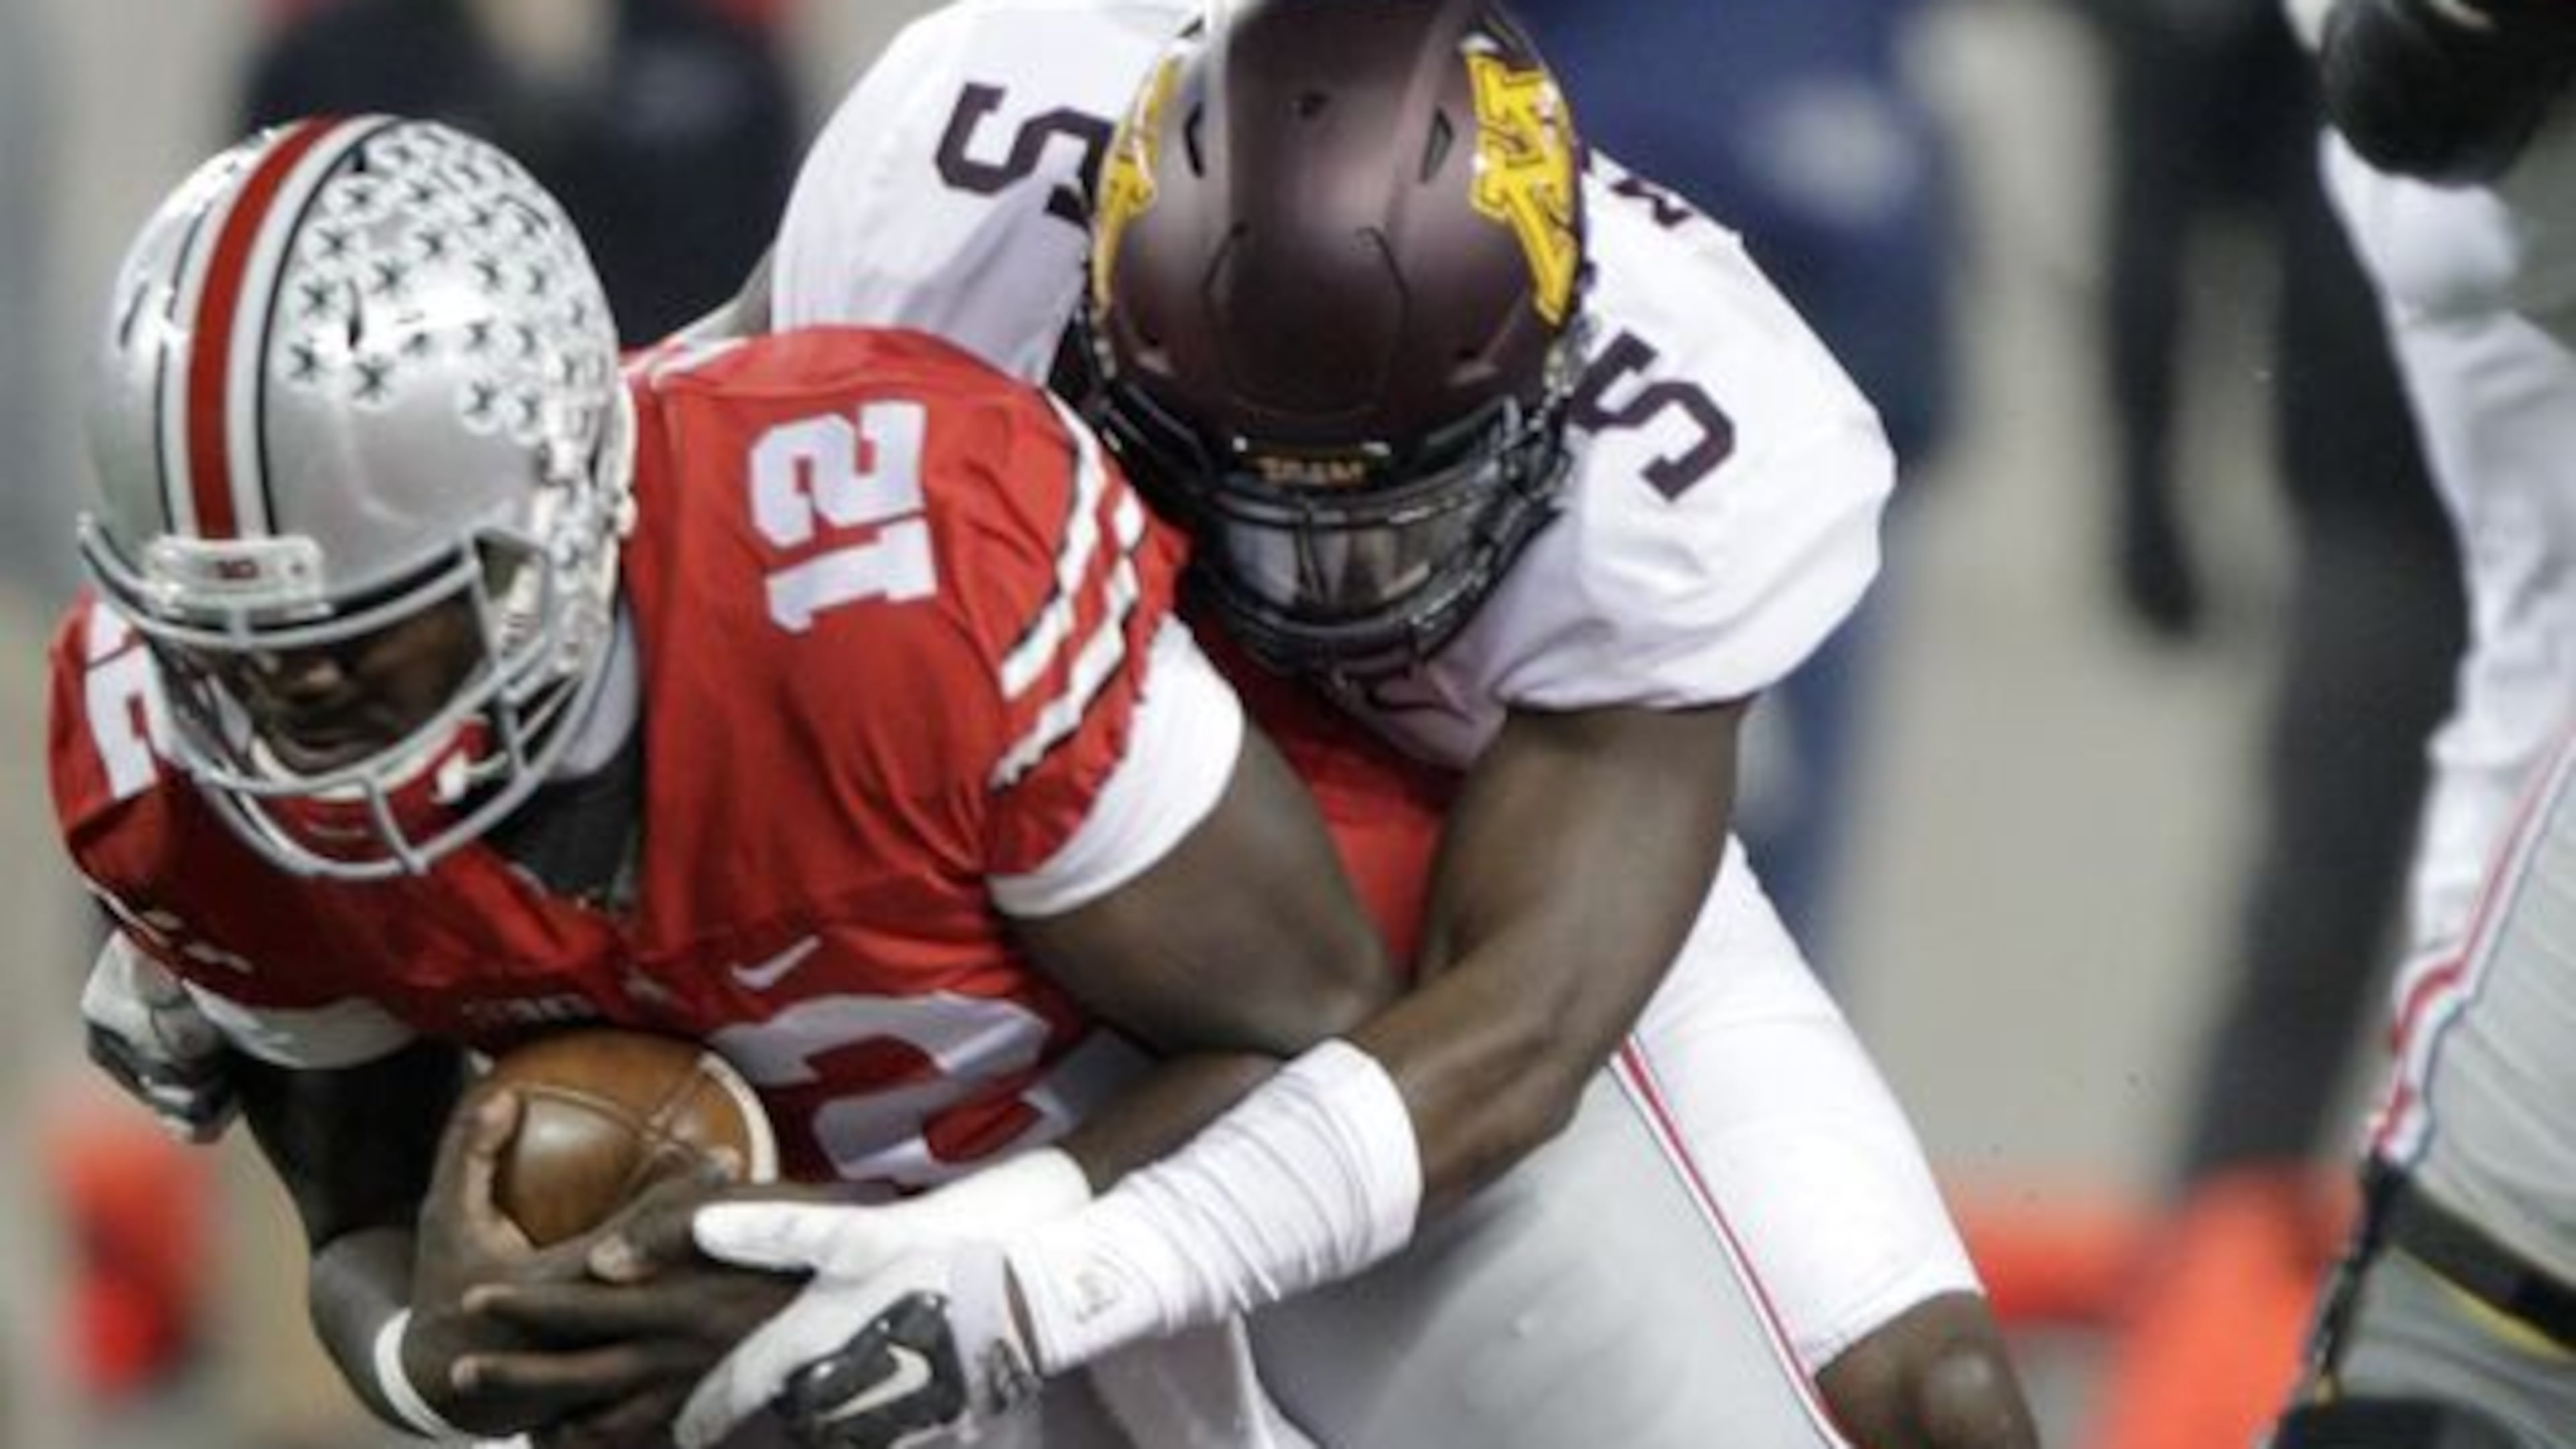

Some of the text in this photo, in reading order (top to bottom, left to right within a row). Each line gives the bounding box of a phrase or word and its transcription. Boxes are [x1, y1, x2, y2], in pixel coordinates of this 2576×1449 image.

[749, 398, 939, 635] 12
[1566, 329, 1736, 502] 5
[708, 989, 1079, 1191] 2
